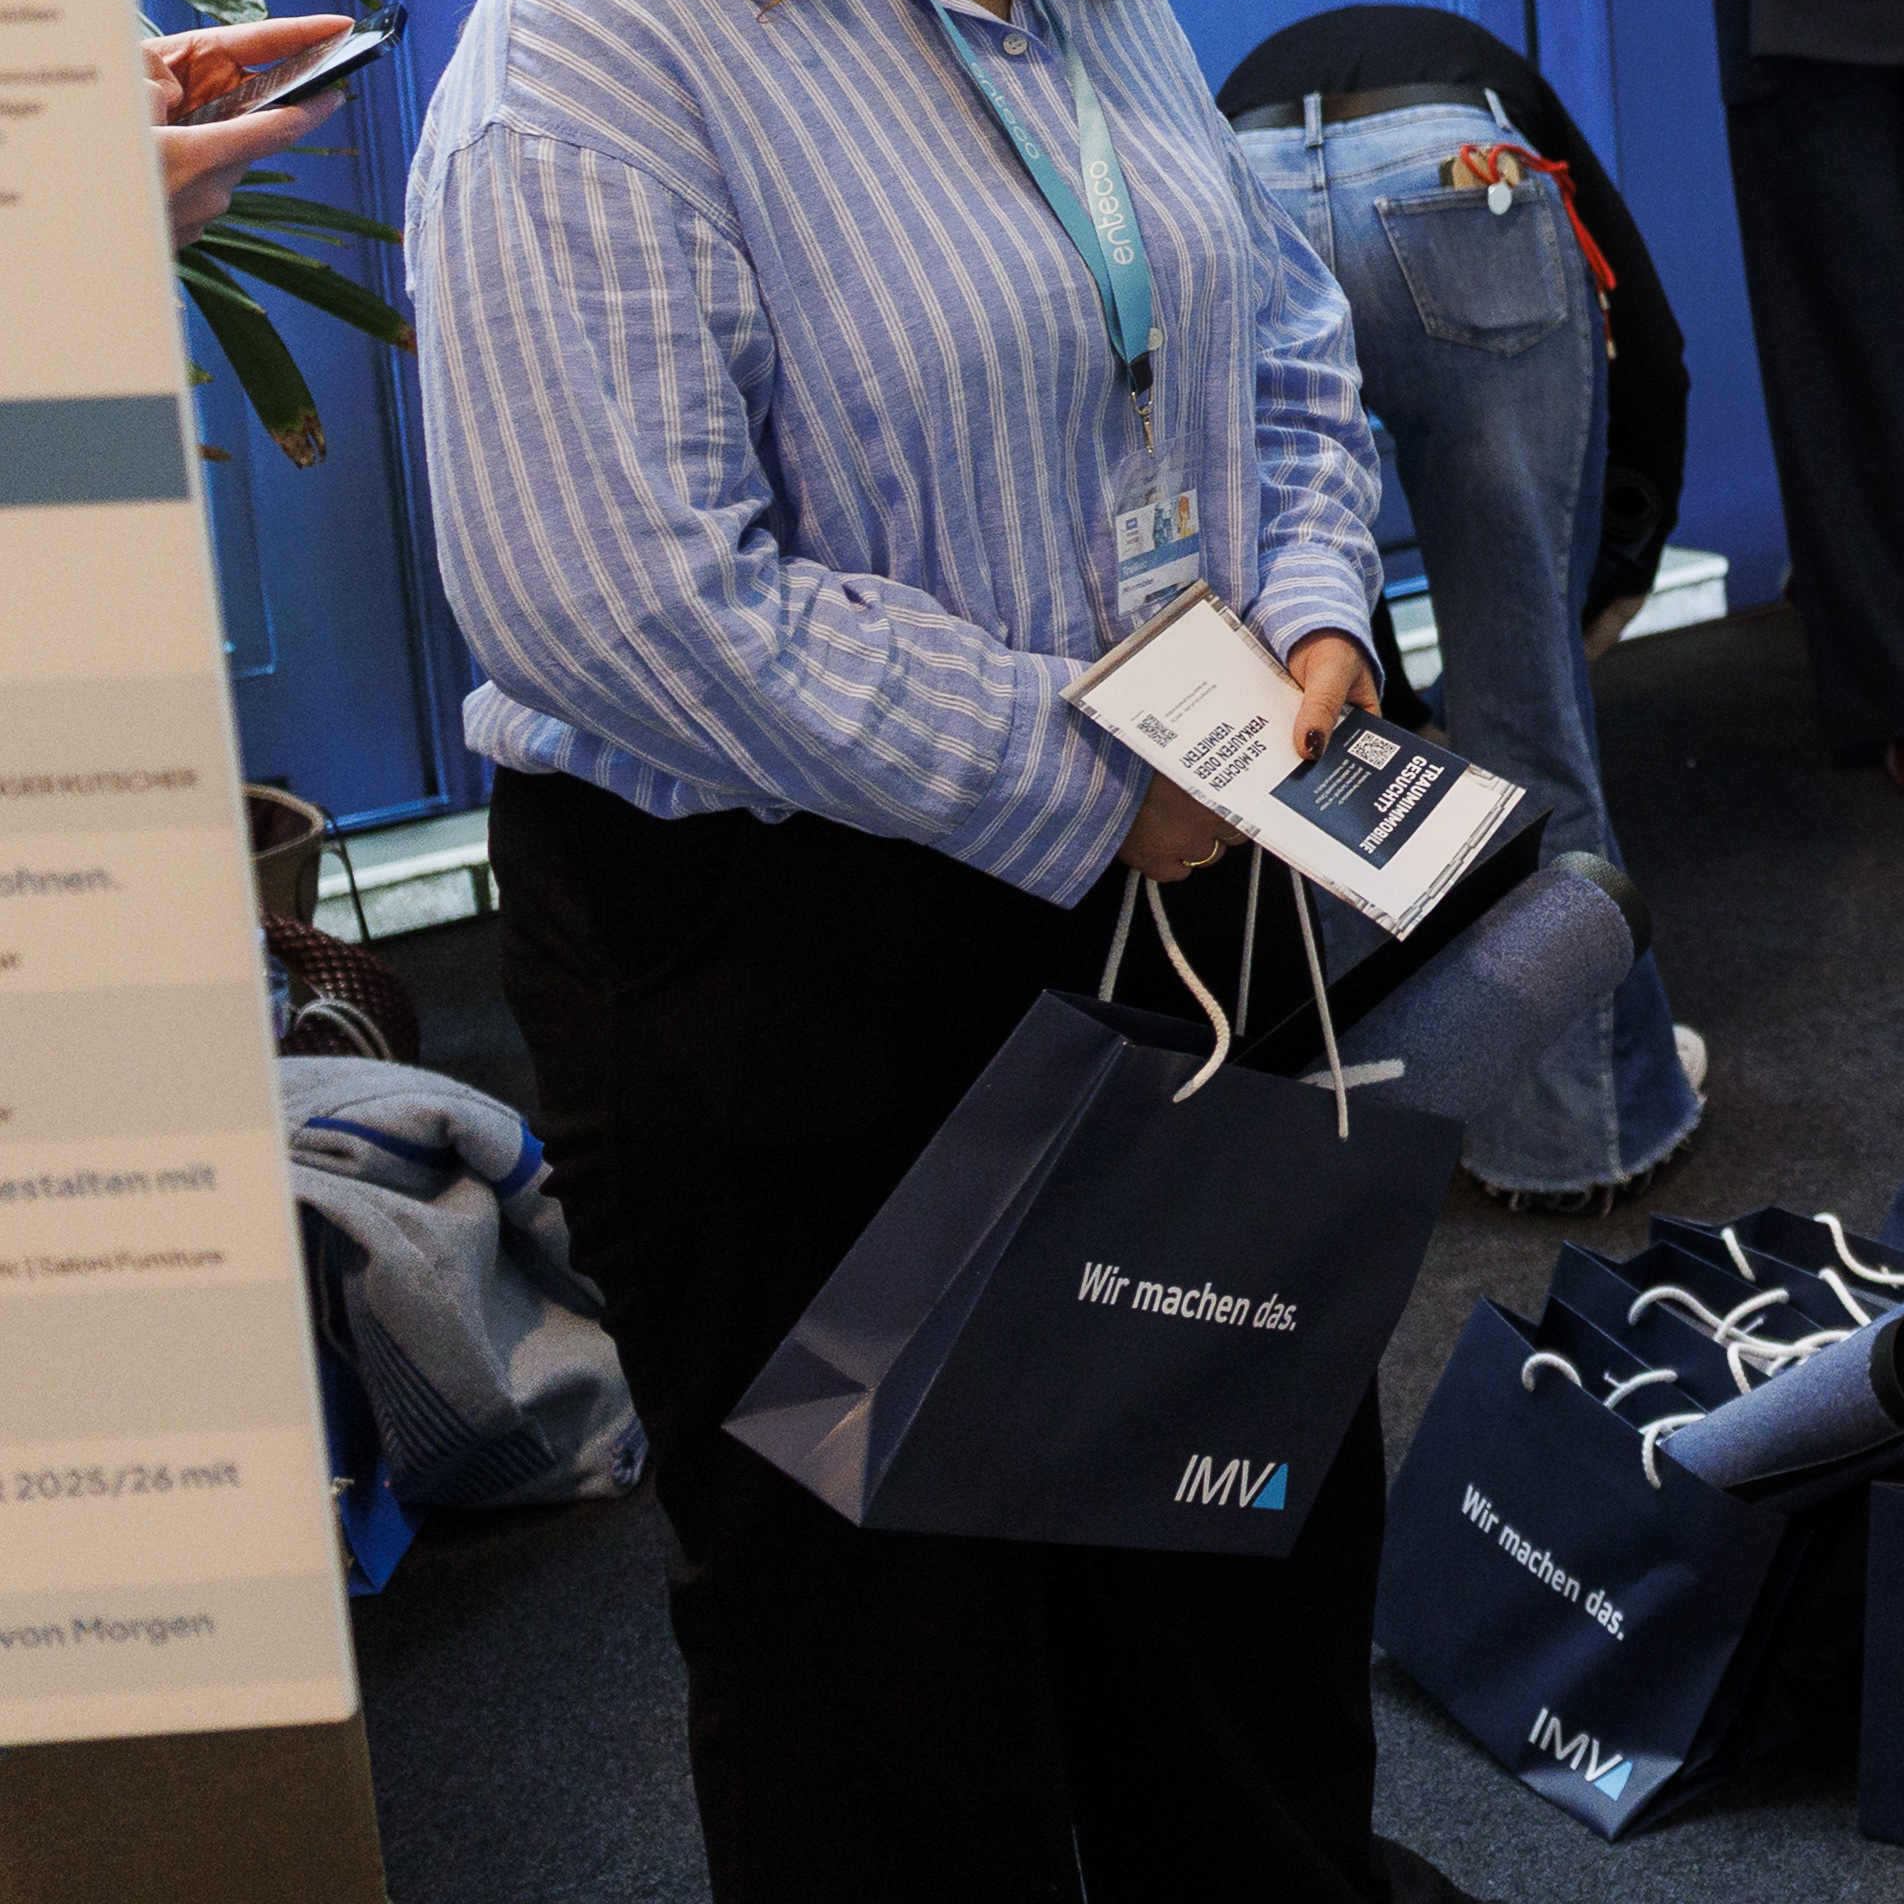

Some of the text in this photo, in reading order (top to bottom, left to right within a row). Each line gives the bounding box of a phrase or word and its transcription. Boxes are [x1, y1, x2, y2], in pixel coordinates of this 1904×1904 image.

[970, 61, 1042, 160] enteco
[1088, 159, 1135, 266] enteco
[1179, 722, 1235, 769] VERMIETEN?
[1193, 715, 1270, 780] VERKAUFEN ODER
[1208, 740, 1267, 792] SIE MÖCHTEN
[1359, 763, 1445, 855] TRAUMIMMOBILIE
[1373, 754, 1429, 814] GESUCHT?
[155, 1163, 216, 1193] mit
[1077, 1262, 1297, 1331] Wir machen das.
[16, 1462, 241, 1502] 2025/26 mit
[1460, 1482, 1625, 1641] Wir machen das.
[71, 1613, 218, 1647] Morgen
